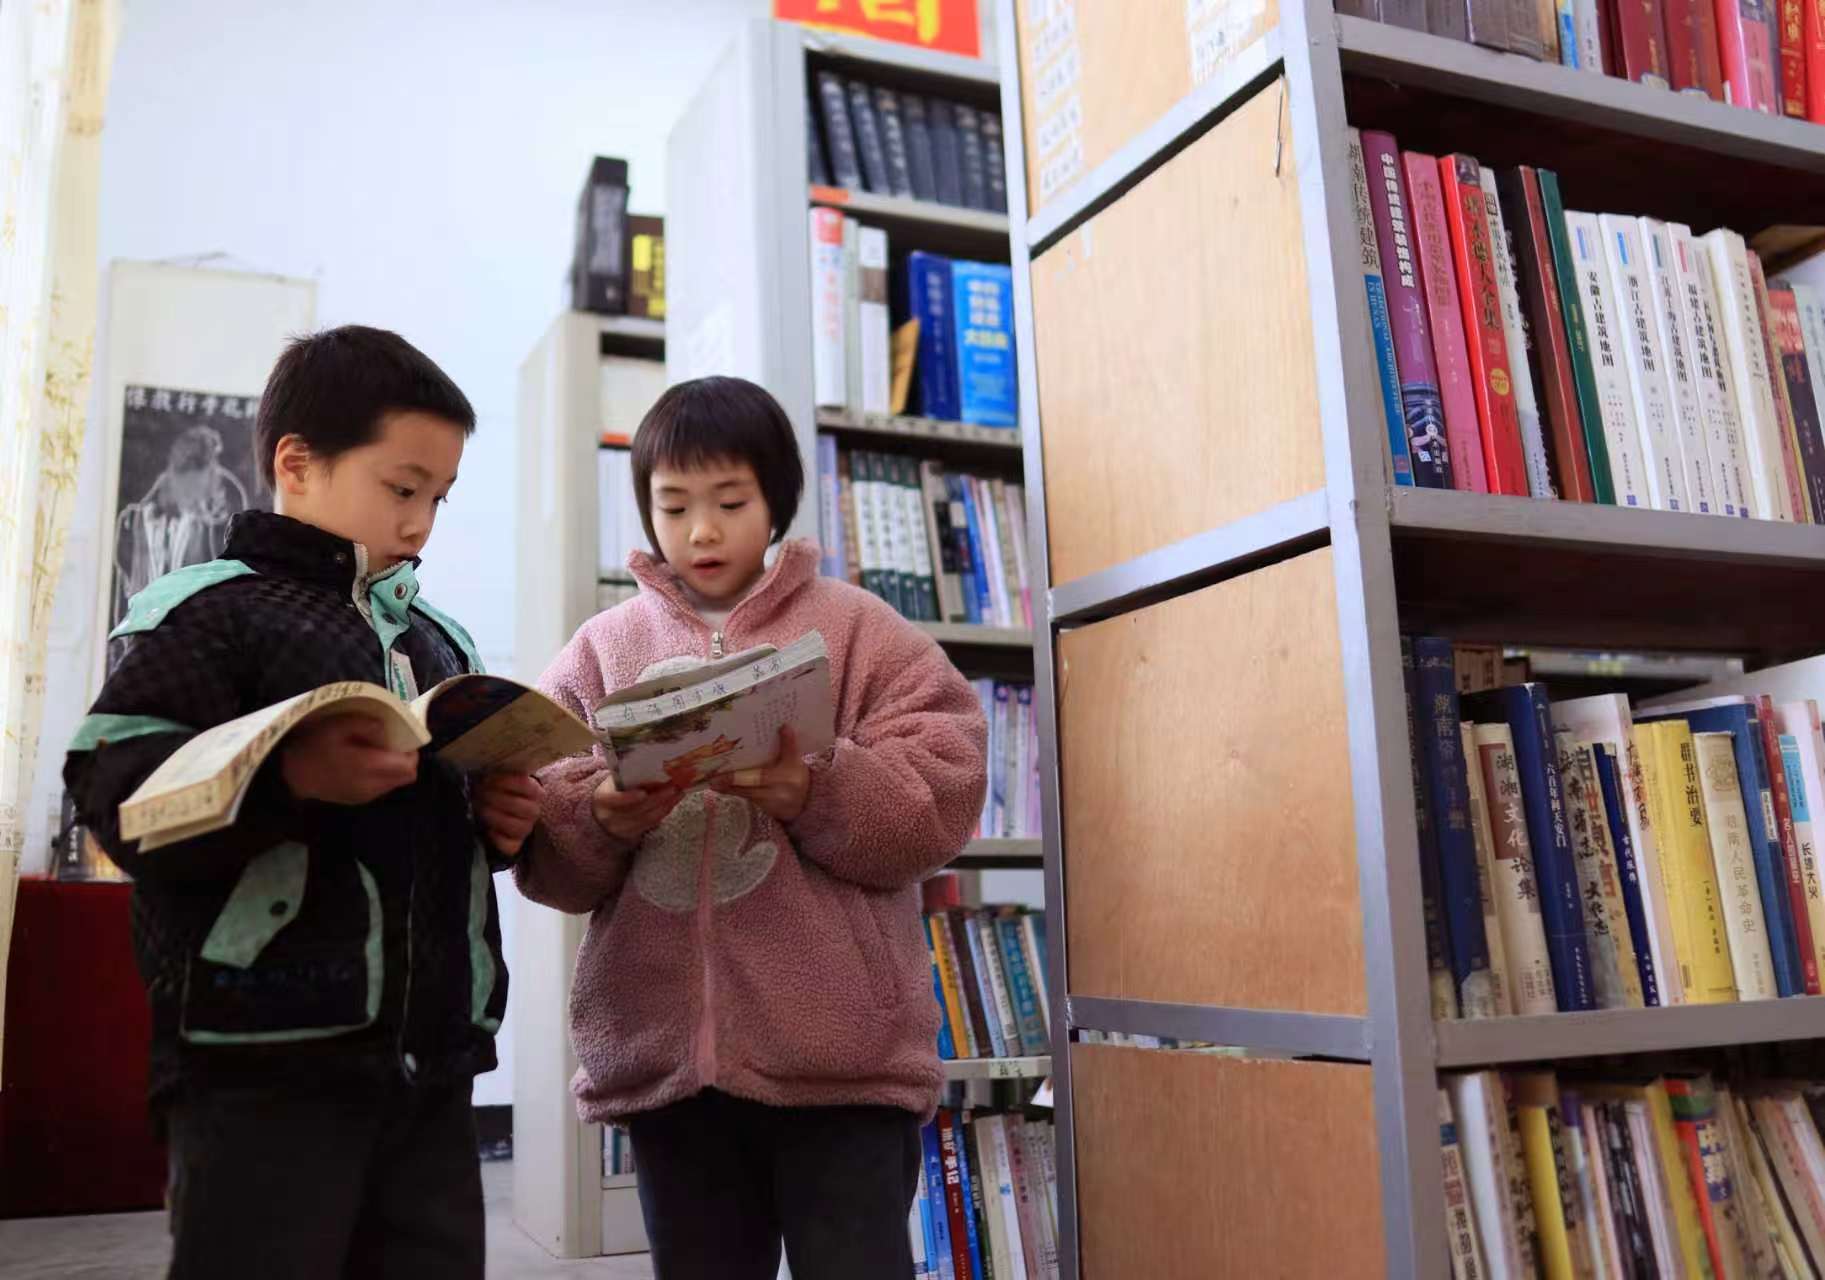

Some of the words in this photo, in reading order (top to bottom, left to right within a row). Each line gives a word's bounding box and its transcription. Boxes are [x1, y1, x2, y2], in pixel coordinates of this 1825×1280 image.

[1496, 754, 1537, 900] 湖湘文化论集
[1680, 742, 1703, 827] 群书治要
